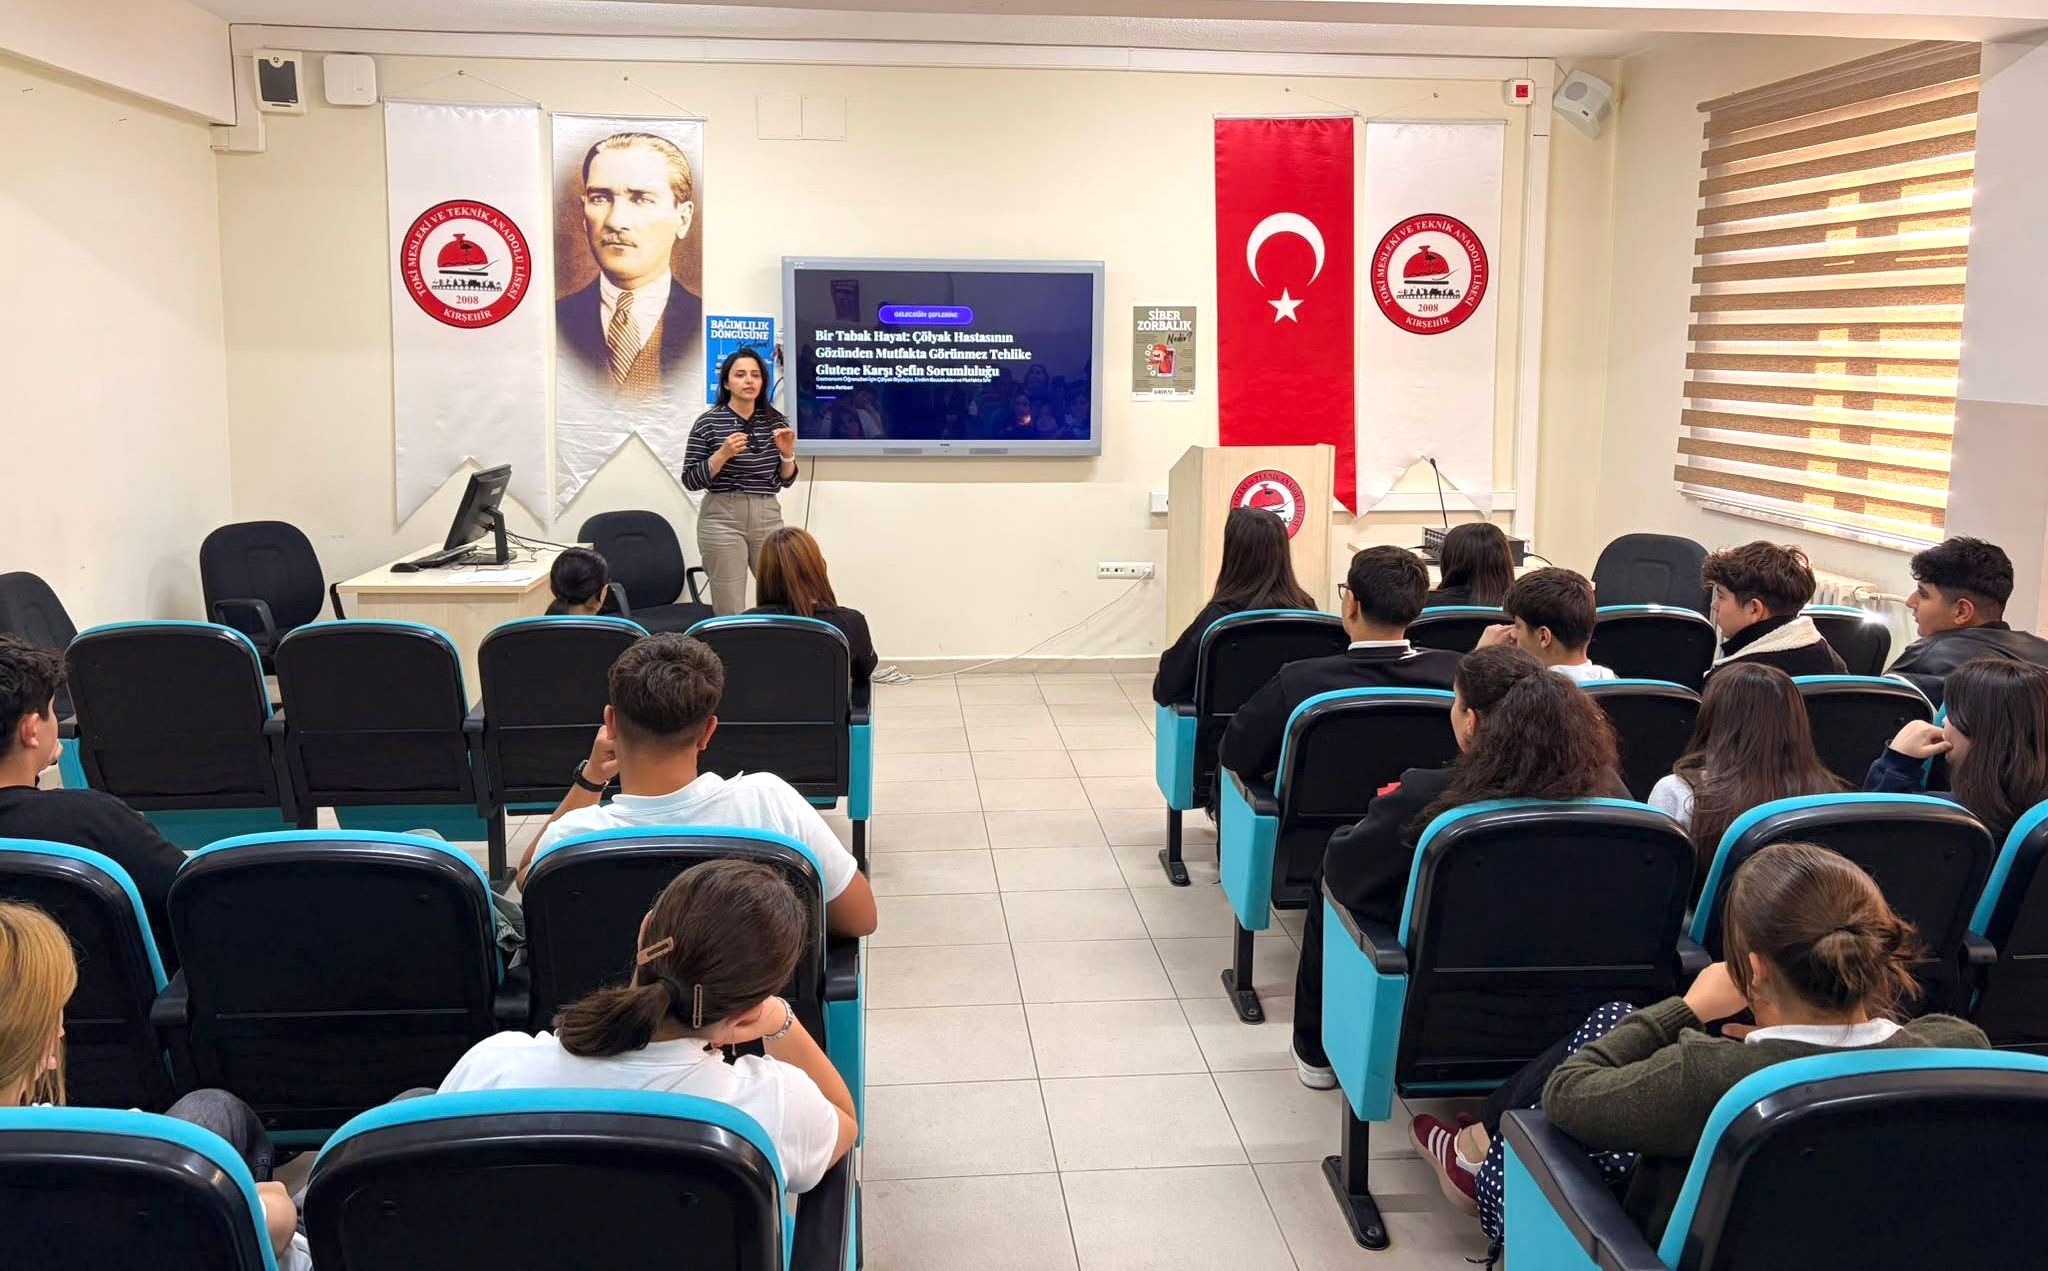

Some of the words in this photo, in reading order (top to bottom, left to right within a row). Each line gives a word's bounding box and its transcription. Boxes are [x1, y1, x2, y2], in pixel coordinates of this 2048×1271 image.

[430, 210, 446, 222] VE
[446, 207, 490, 221] TEKNİK
[1400, 225, 1414, 236] VE
[1414, 220, 1454, 233] TEKNİK
[408, 219, 432, 267] MESLEKİ
[490, 218, 524, 262] ANADOLU
[1377, 232, 1401, 278] MESLEKİ
[1454, 229, 1482, 271] ANADOLU
[408, 269, 427, 297] TOKİ
[507, 265, 525, 300] LİSESİ
[1465, 274, 1482, 307] LİSESİ
[456, 295, 479, 304] 2008
[1148, 308, 1180, 320] SİBER
[1418, 304, 1439, 312] 2008
[443, 308, 492, 323] KIRŞEHİR
[1405, 316, 1450, 329] KIRŞEHİR
[711, 318, 769, 330] BAĞIMLILIK
[1137, 320, 1191, 331] ZORBALIK
[816, 330, 834, 342] Bir
[836, 330, 870, 342] Tabak
[874, 331, 910, 345] Hayat:
[912, 331, 952, 345] Çölyak
[954, 332, 1014, 343] Hastasının
[1166, 332, 1192, 344] Nedir?
[816, 347, 873, 359] Gözünden
[875, 348, 927, 360] Mutfakta
[929, 348, 987, 361] Görünmez
[990, 349, 1032, 361] Tehlike
[816, 364, 861, 376] Glutene
[863, 365, 893, 378] Karşı
[895, 365, 925, 378] Şefin
[926, 365, 1000, 379] Sorumluluğu
